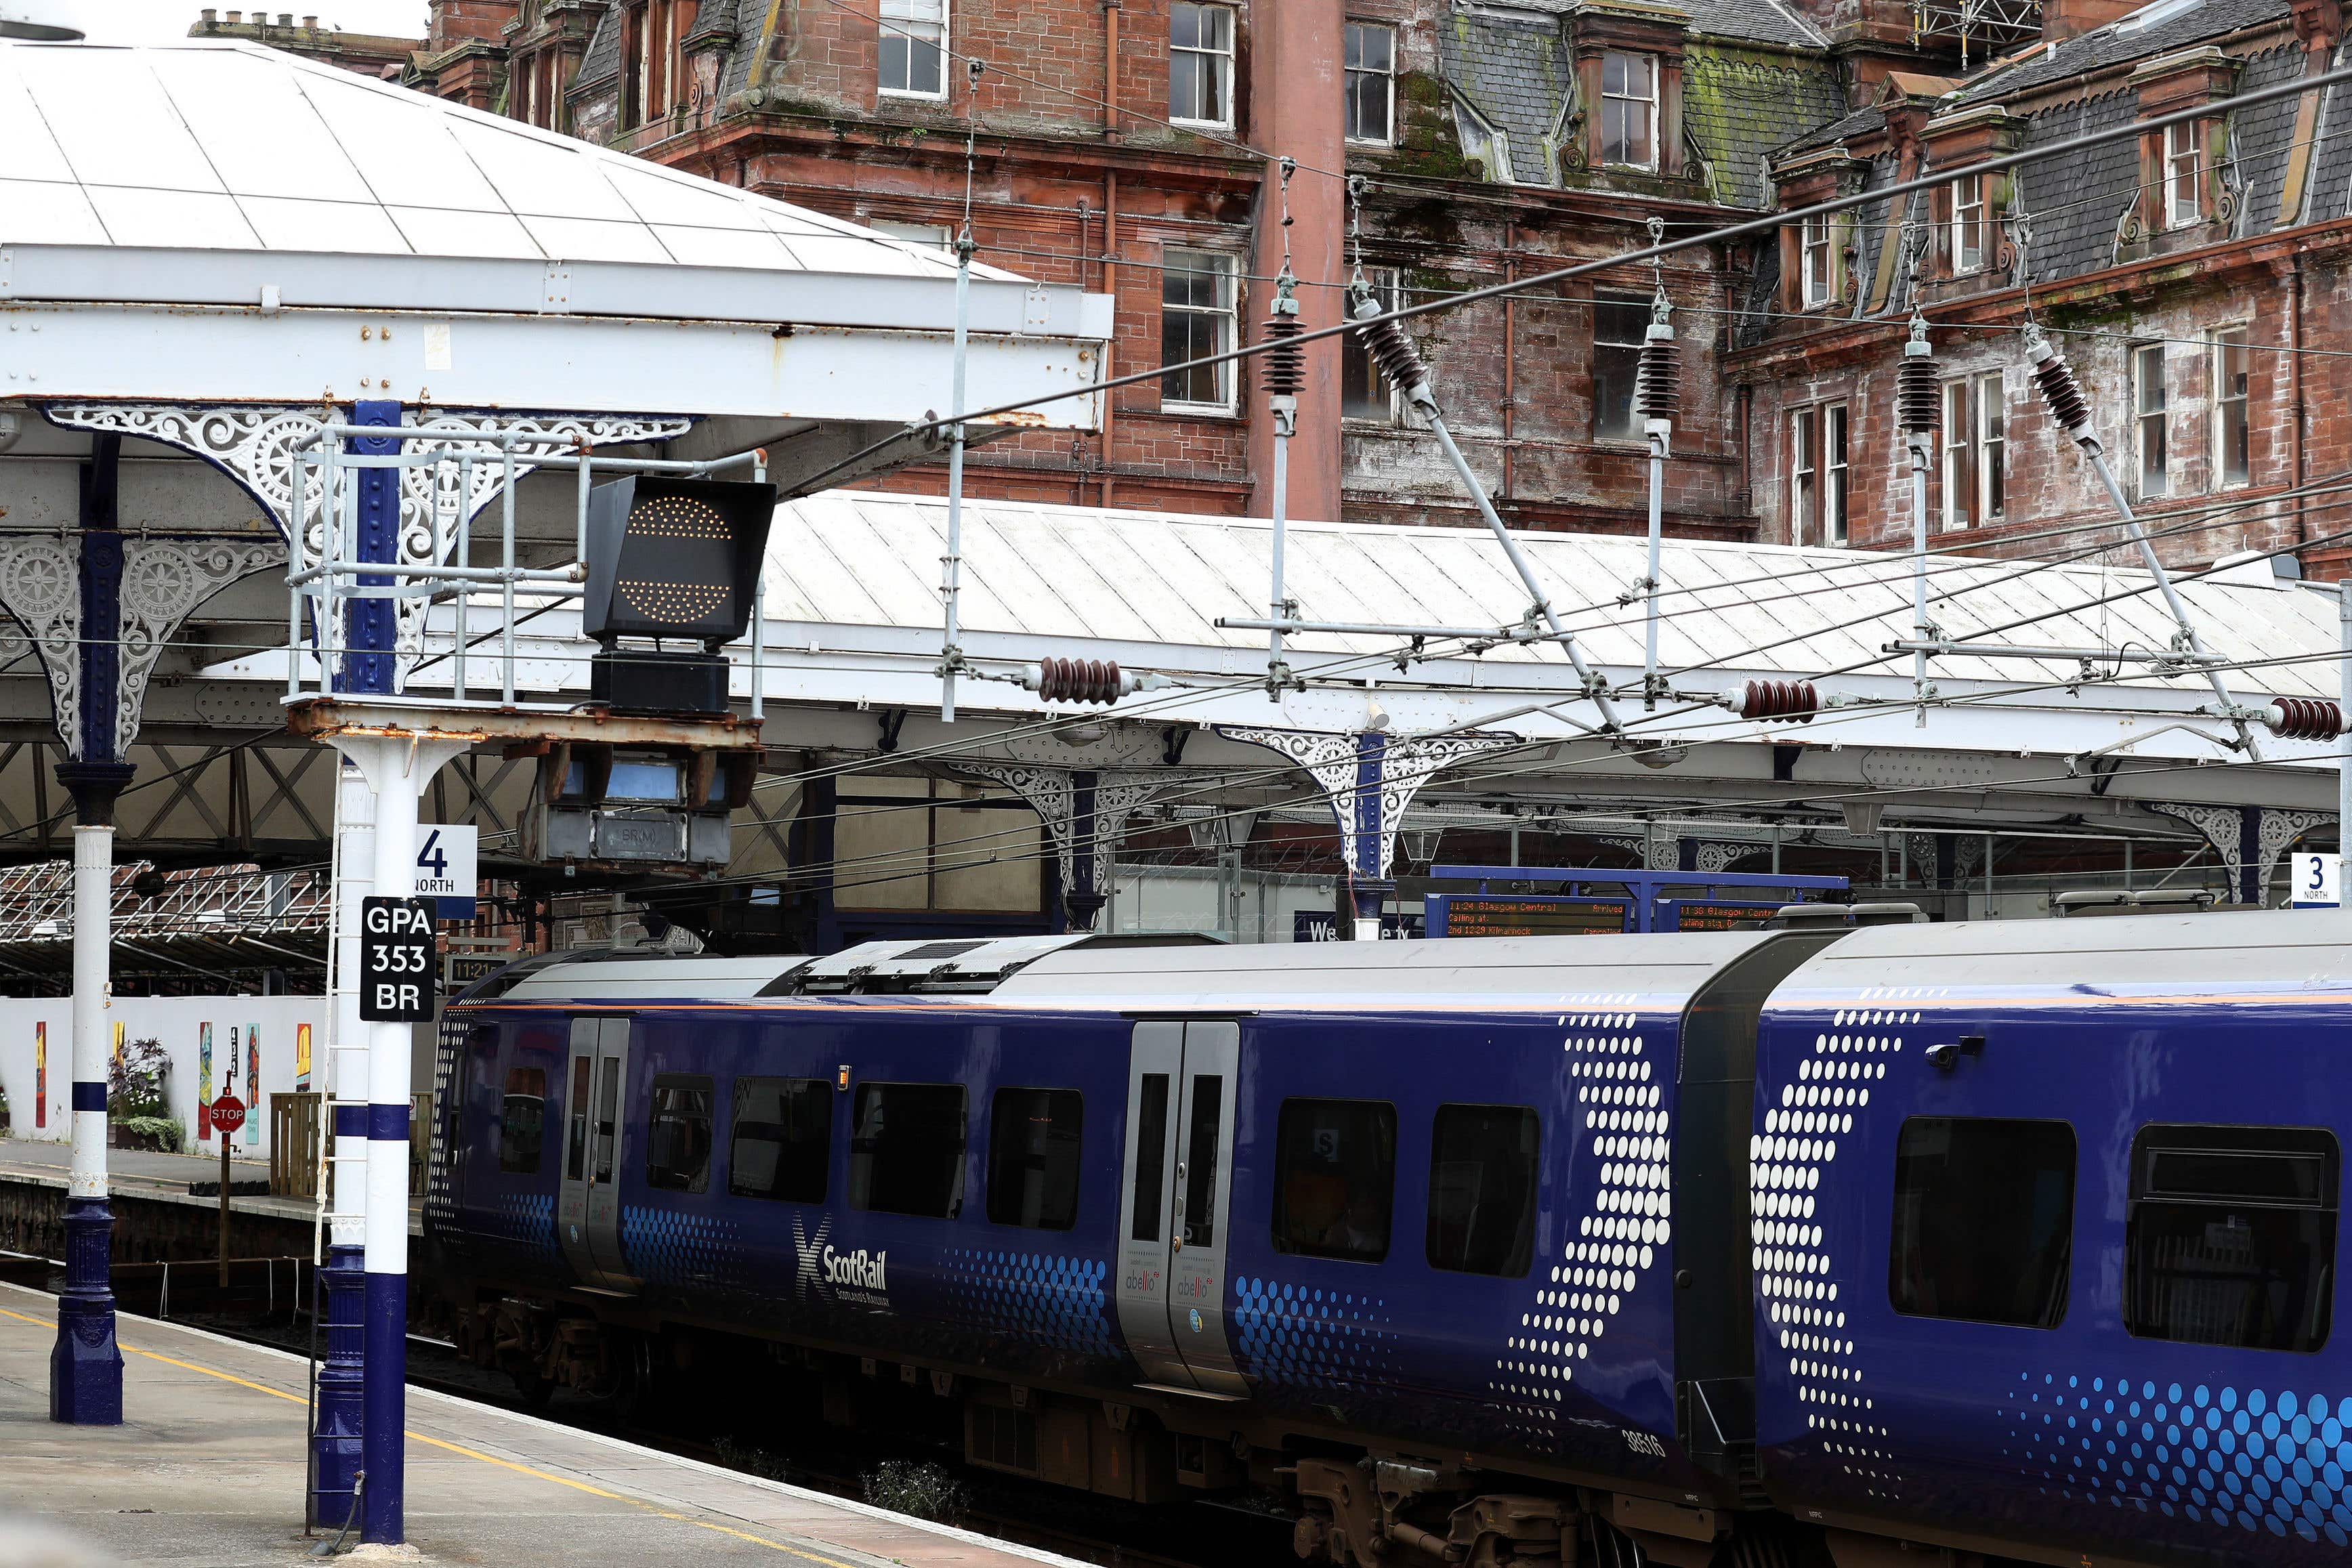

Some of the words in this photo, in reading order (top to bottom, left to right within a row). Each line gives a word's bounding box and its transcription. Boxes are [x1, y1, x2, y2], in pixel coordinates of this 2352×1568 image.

[417, 829, 448, 878] 4
[2309, 857, 2323, 889] 3
[2304, 891, 2328, 899] NORTH
[1450, 902, 1474, 910] 11:24
[1479, 902, 1516, 912] Glasgow
[1520, 903, 1556, 912] Central
[1593, 904, 1623, 913] Arrived
[1708, 908, 1744, 918] Glasgow
[1748, 908, 1778, 917] Centra
[366, 907, 432, 935] GPA
[1449, 914, 1474, 923] Calling
[1679, 918, 1704, 929] Calling
[1448, 925, 1462, 934] 2nd
[1465, 926, 1486, 935] 12:29
[372, 946, 426, 972] 353
[455, 962, 488, 978] 11:21
[376, 984, 419, 1010] BR
[212, 1109, 243, 1119] STOP
[824, 1244, 886, 1290] ScotRail
[1127, 1269, 1155, 1291] abellio
[1178, 1276, 1207, 1298] abellio
[866, 1292, 889, 1307] RAILWAY
[1622, 1430, 1666, 1457] 38516
